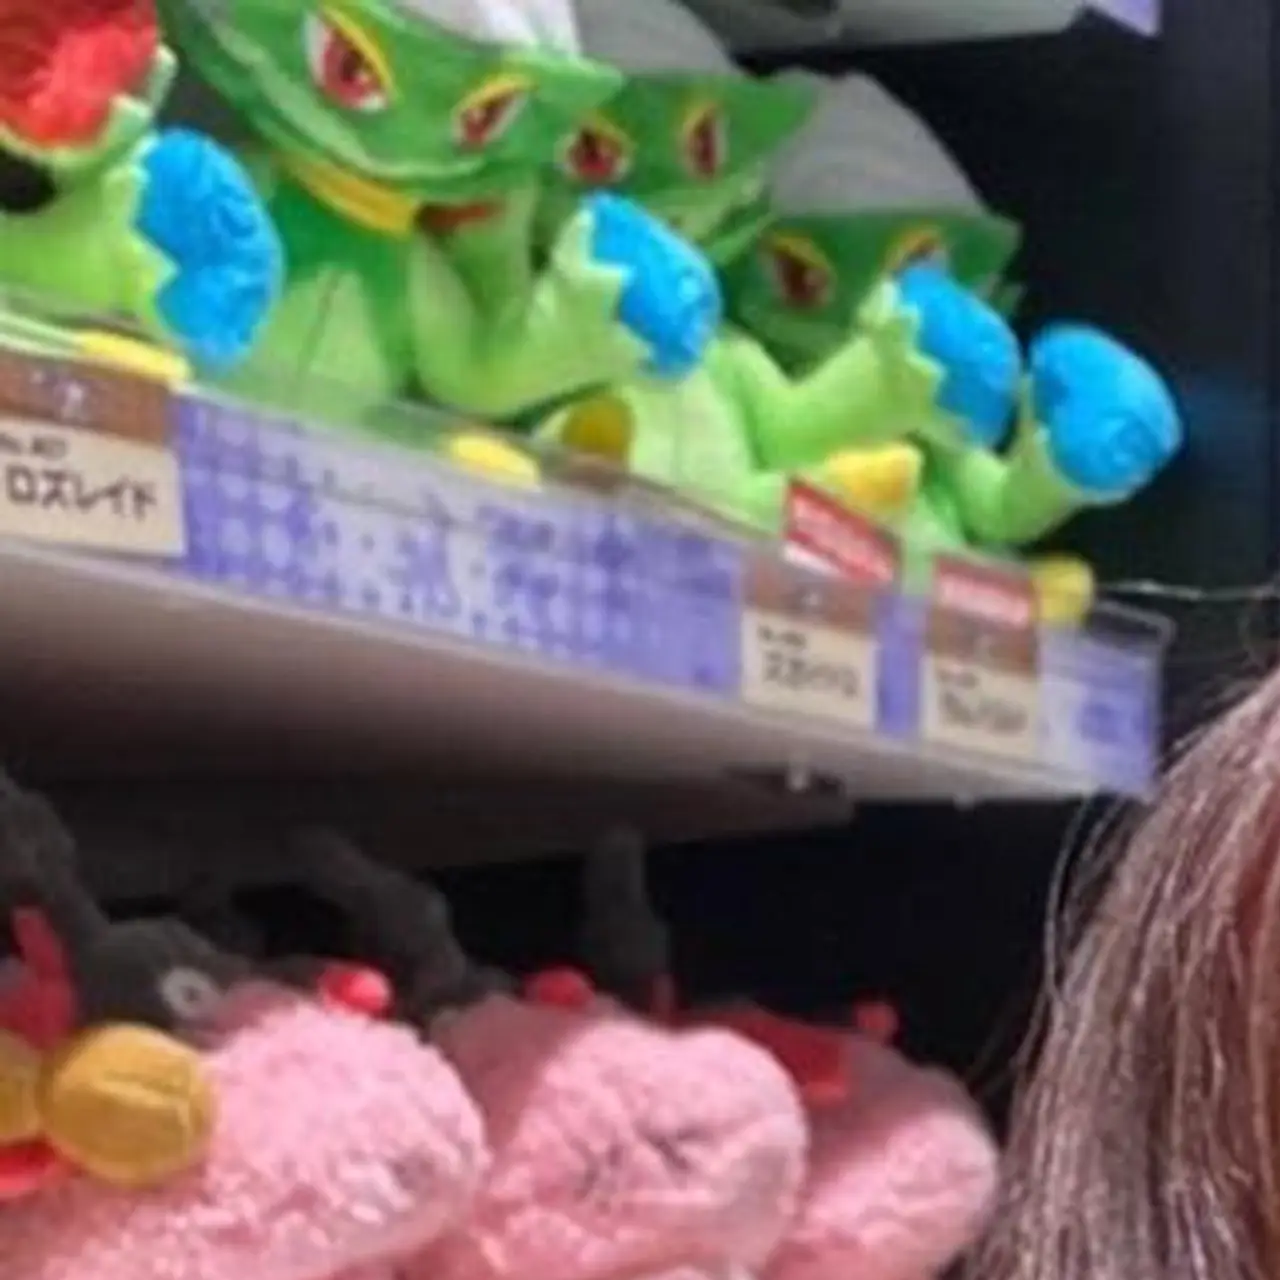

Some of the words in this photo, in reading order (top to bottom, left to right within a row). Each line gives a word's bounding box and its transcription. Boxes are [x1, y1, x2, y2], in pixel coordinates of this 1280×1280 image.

[5, 463, 157, 521] ロズレイド
